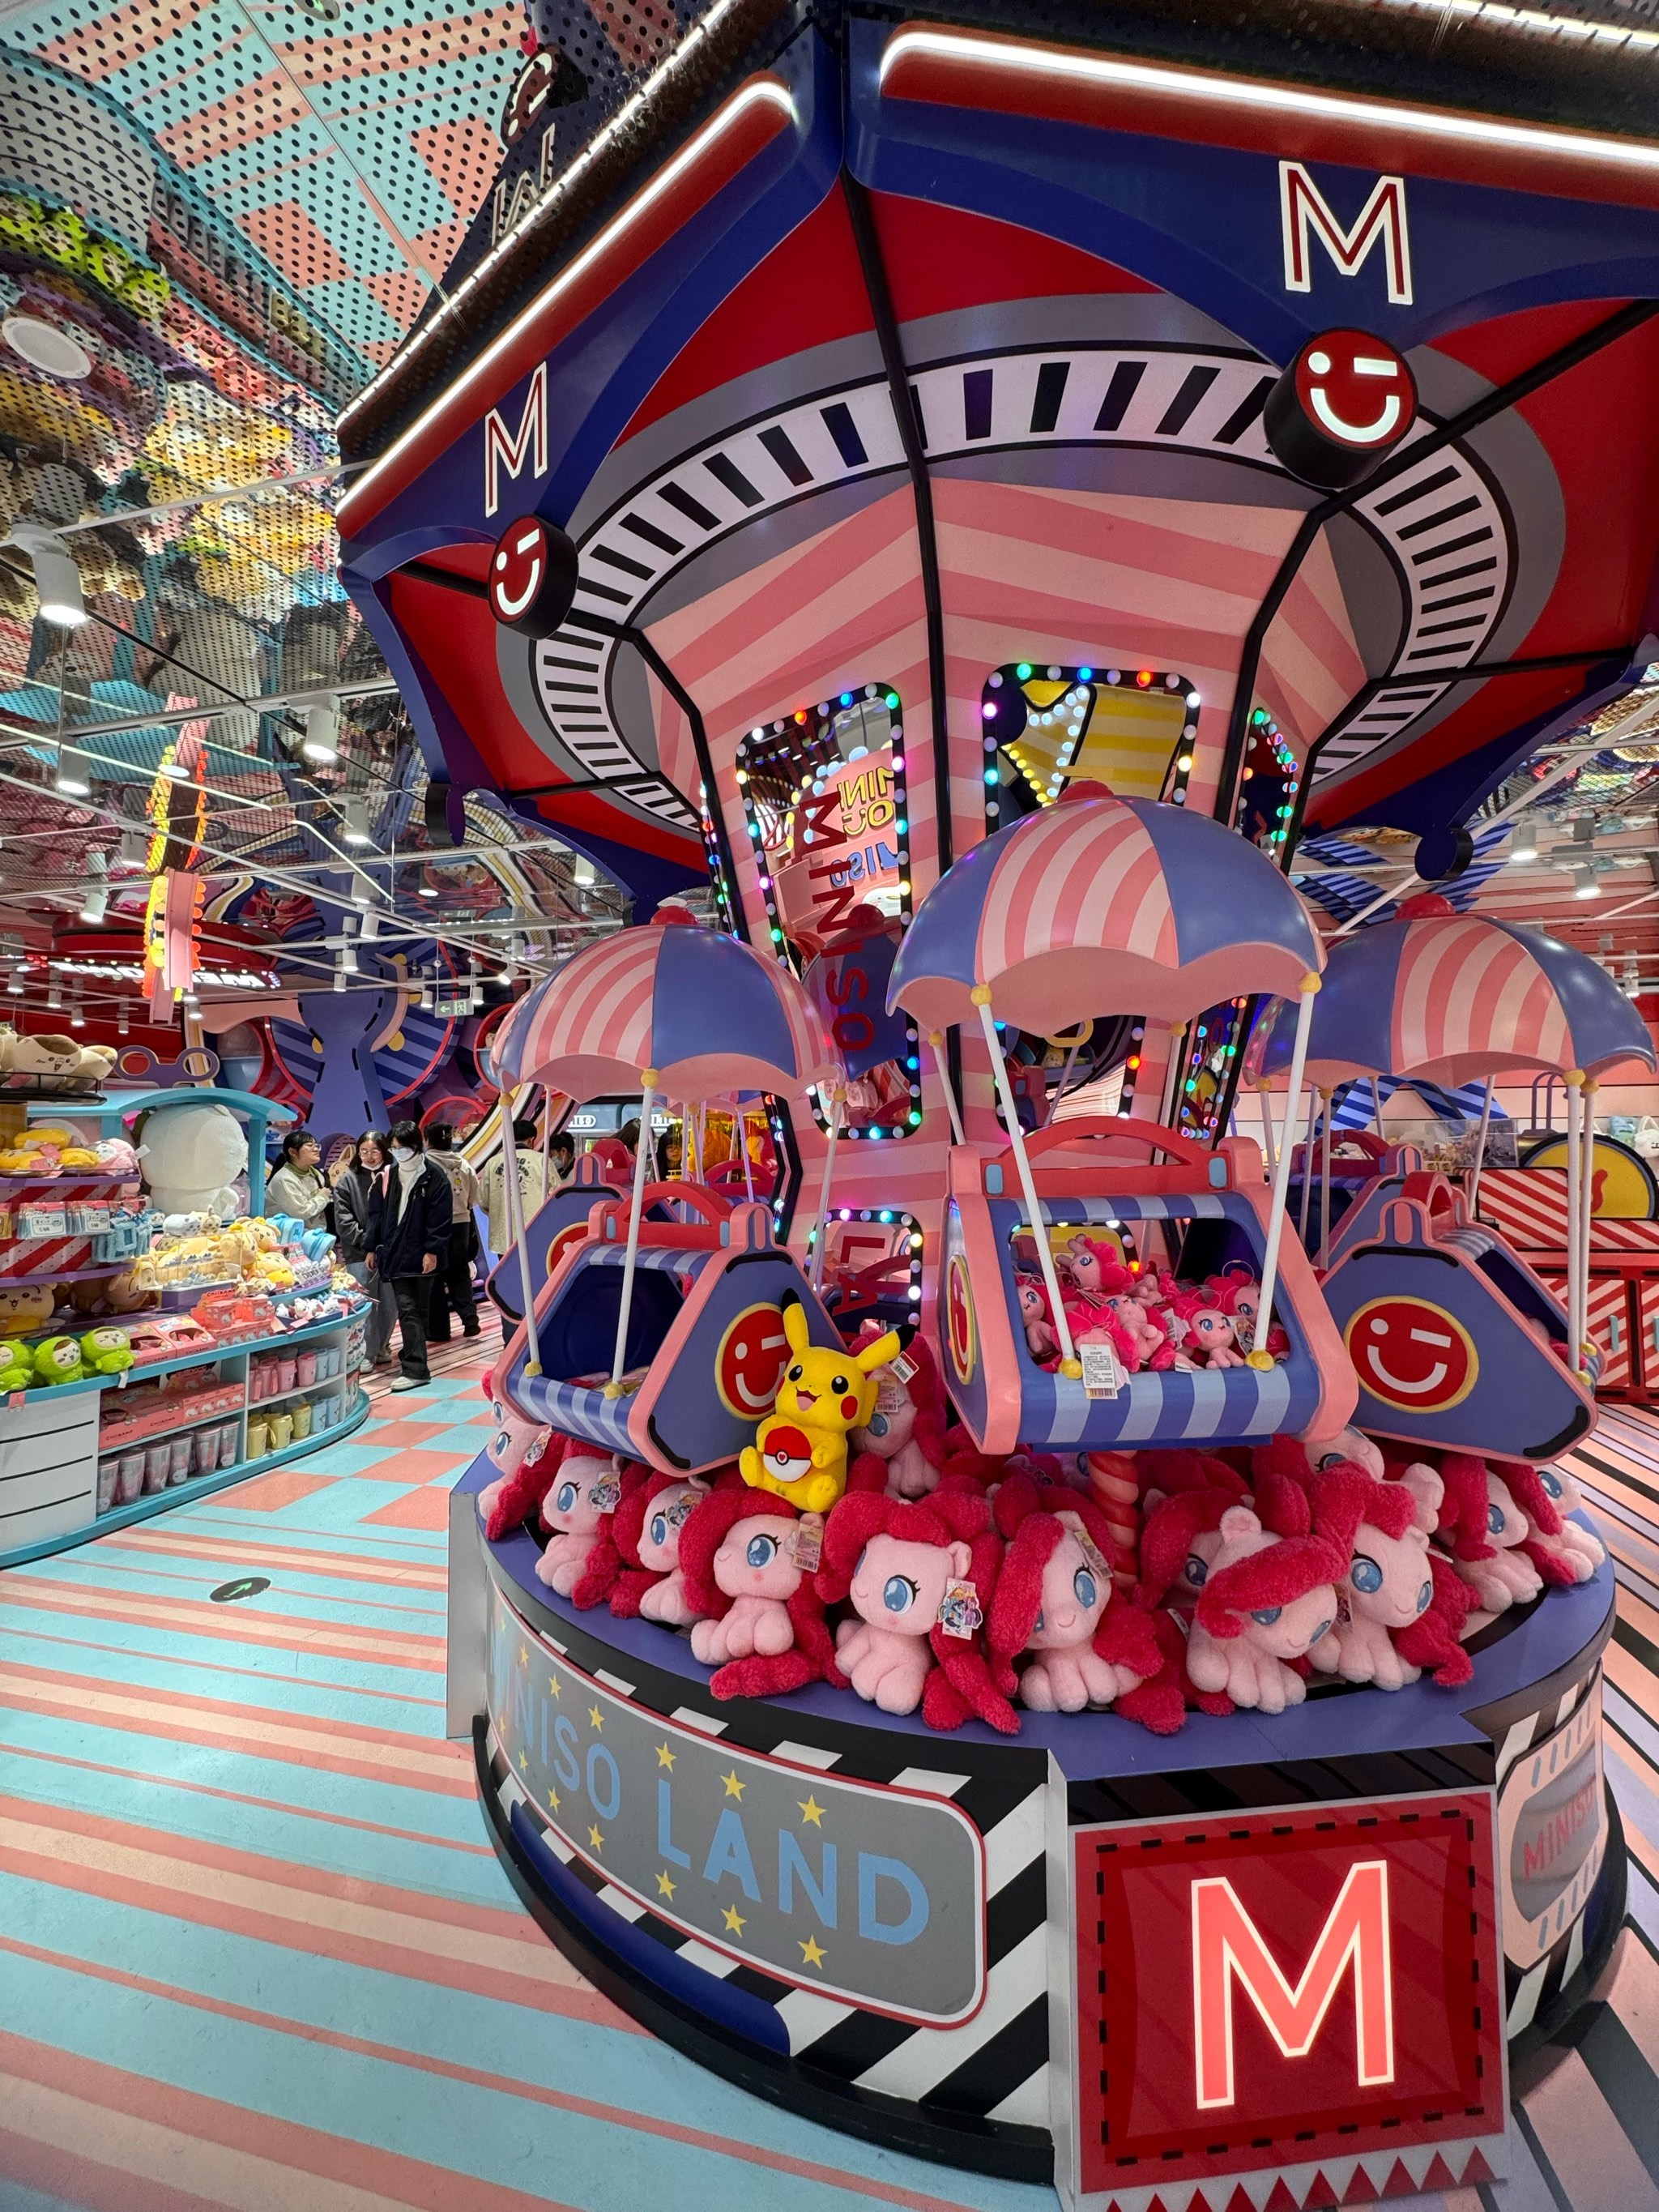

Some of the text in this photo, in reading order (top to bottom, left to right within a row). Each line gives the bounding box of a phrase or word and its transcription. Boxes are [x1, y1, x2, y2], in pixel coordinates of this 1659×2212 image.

[1278, 160, 1414, 305] M
[484, 361, 548, 518] M
[799, 791, 875, 1052] MINISO
[833, 1236, 886, 1317] LA
[657, 1779, 930, 1946] LAND
[1523, 1774, 1597, 1881] MINISO
[1191, 1860, 1395, 2110] M
